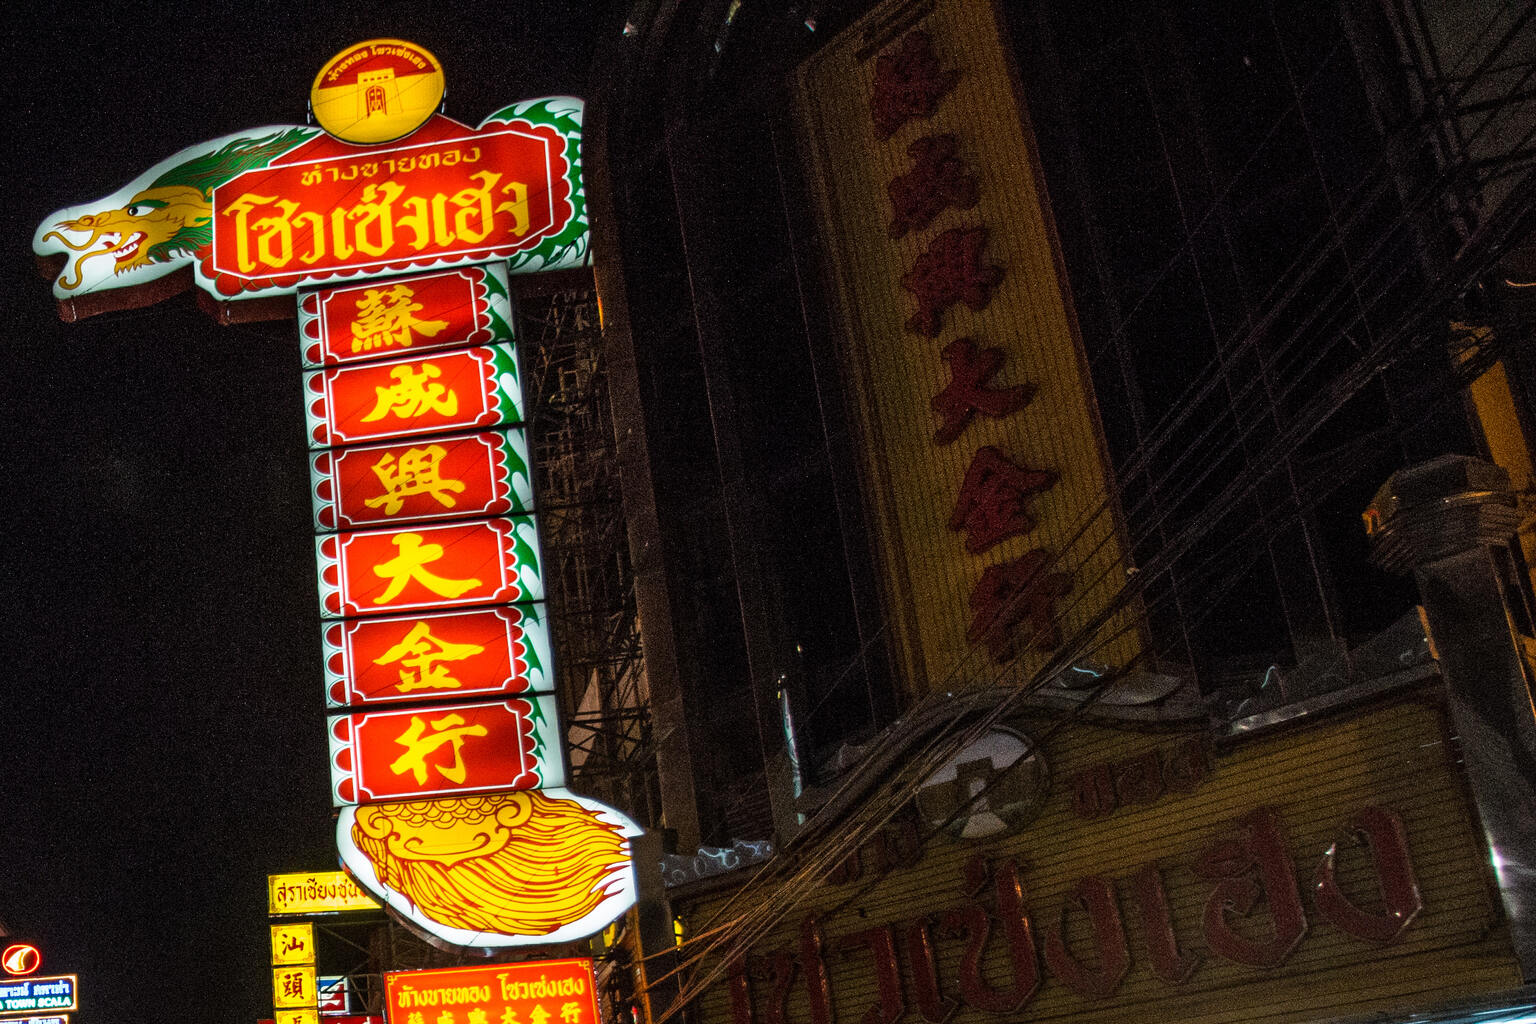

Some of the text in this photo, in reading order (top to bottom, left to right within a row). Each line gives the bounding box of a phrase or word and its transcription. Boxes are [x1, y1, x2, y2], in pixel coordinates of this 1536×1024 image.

[300, 144, 482, 188] ห้างขายทอง
[223, 170, 531, 274] โซวเซ่งเฮง
[350, 286, 488, 786] 蘇成興大金行
[5, 998, 37, 1010] TOWN
[37, 996, 72, 1008] SCALA
[398, 985, 491, 1008] ห้างขายทอง
